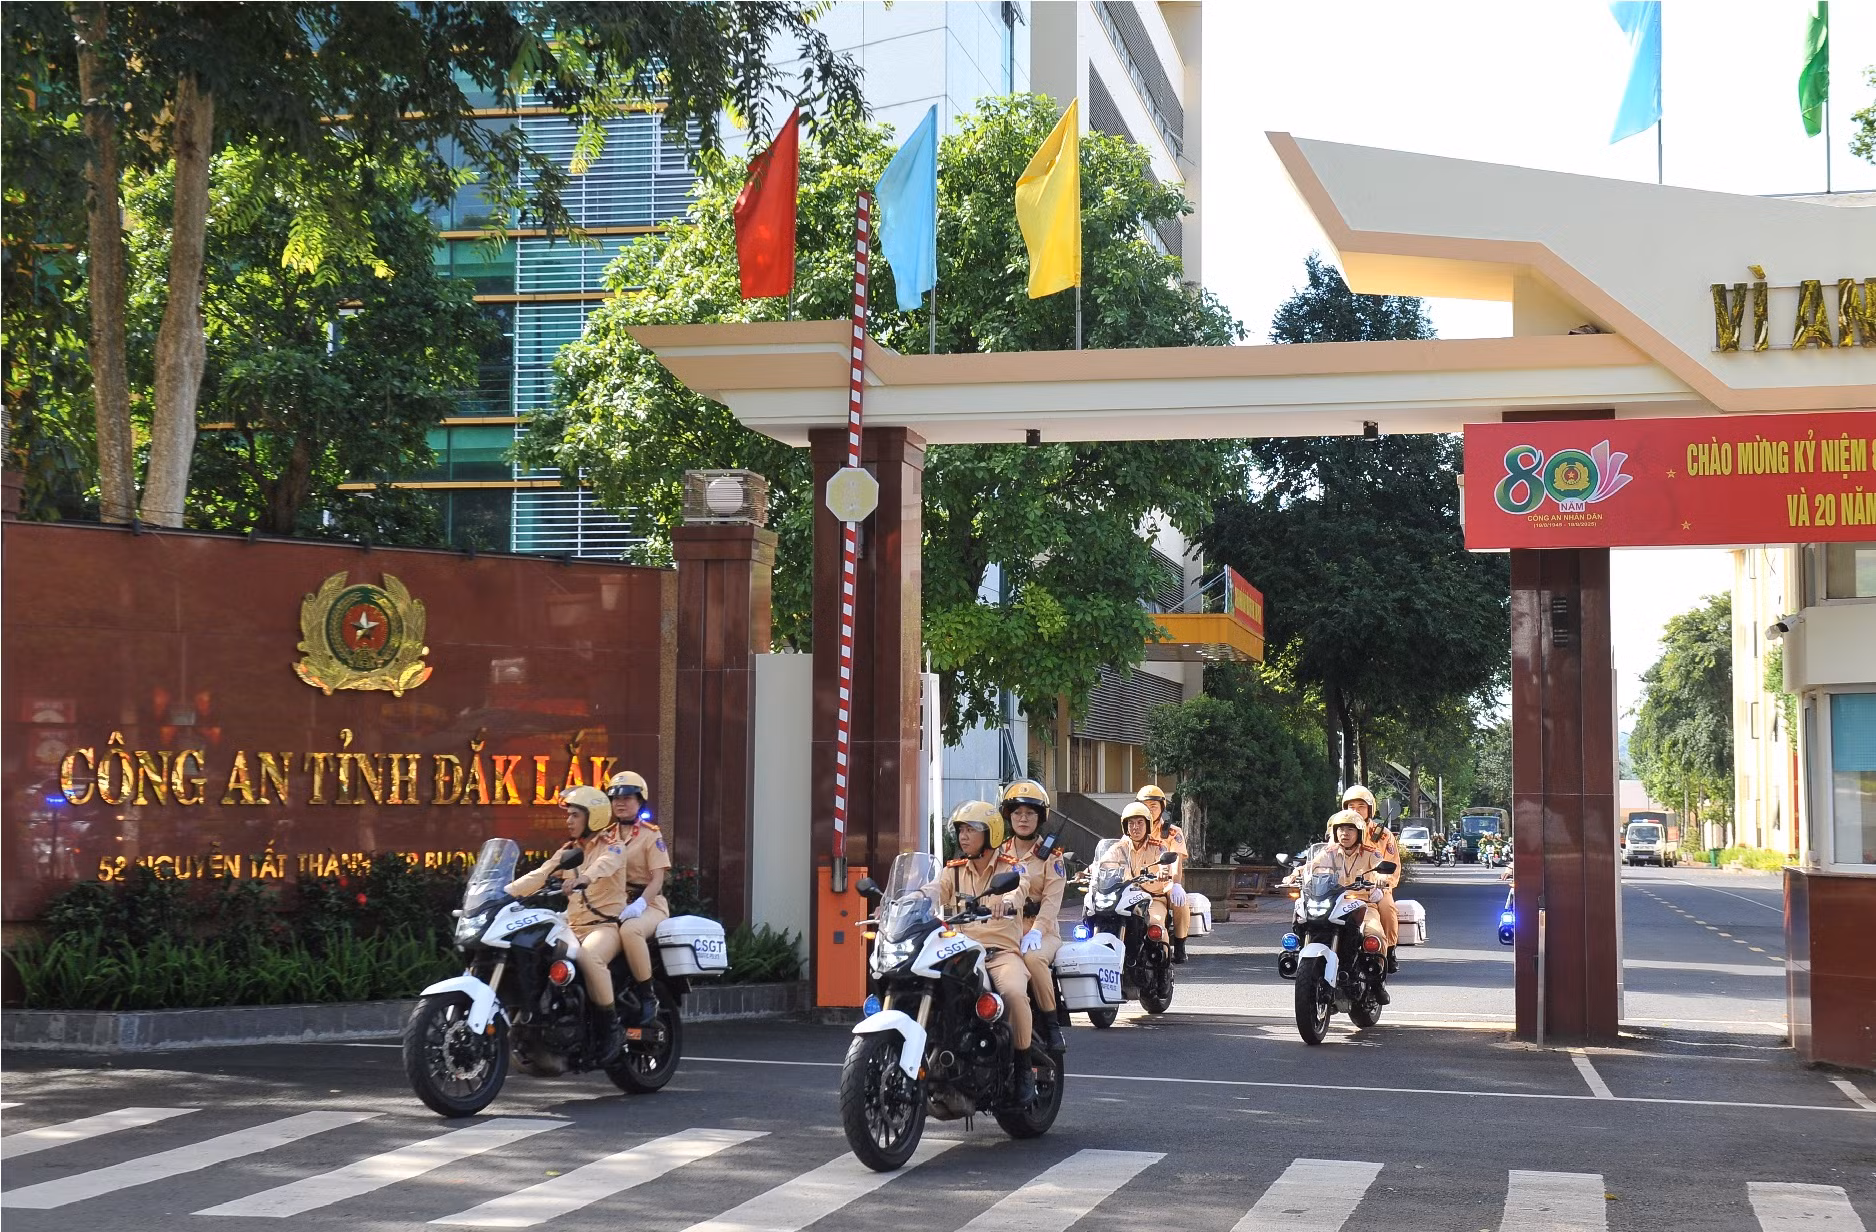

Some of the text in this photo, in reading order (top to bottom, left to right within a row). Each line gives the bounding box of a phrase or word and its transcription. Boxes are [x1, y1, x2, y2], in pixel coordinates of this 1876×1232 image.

[1711, 264, 1876, 352] VÌ AN
[1687, 436, 1732, 476] CHÀO
[1737, 435, 1789, 474] MỪNG
[1794, 429, 1816, 473] KỶ
[1821, 433, 1867, 479] NIỆM
[1527, 513, 1550, 522] CÔNG
[1563, 513, 1585, 521] NHÂN
[1586, 512, 1603, 520] DÂN
[1787, 487, 1810, 527] VÀ
[1815, 494, 1836, 526] 20
[61, 731, 207, 806] CÔNG
[221, 750, 293, 806] AN
[303, 728, 421, 806] TỈNH
[431, 727, 522, 806] ĐẮK
[1129, 893, 1145, 905] CSGT
[1342, 901, 1360, 913] CSGT
[506, 914, 540, 931] CSGT
[936, 940, 968, 960] CSGT
